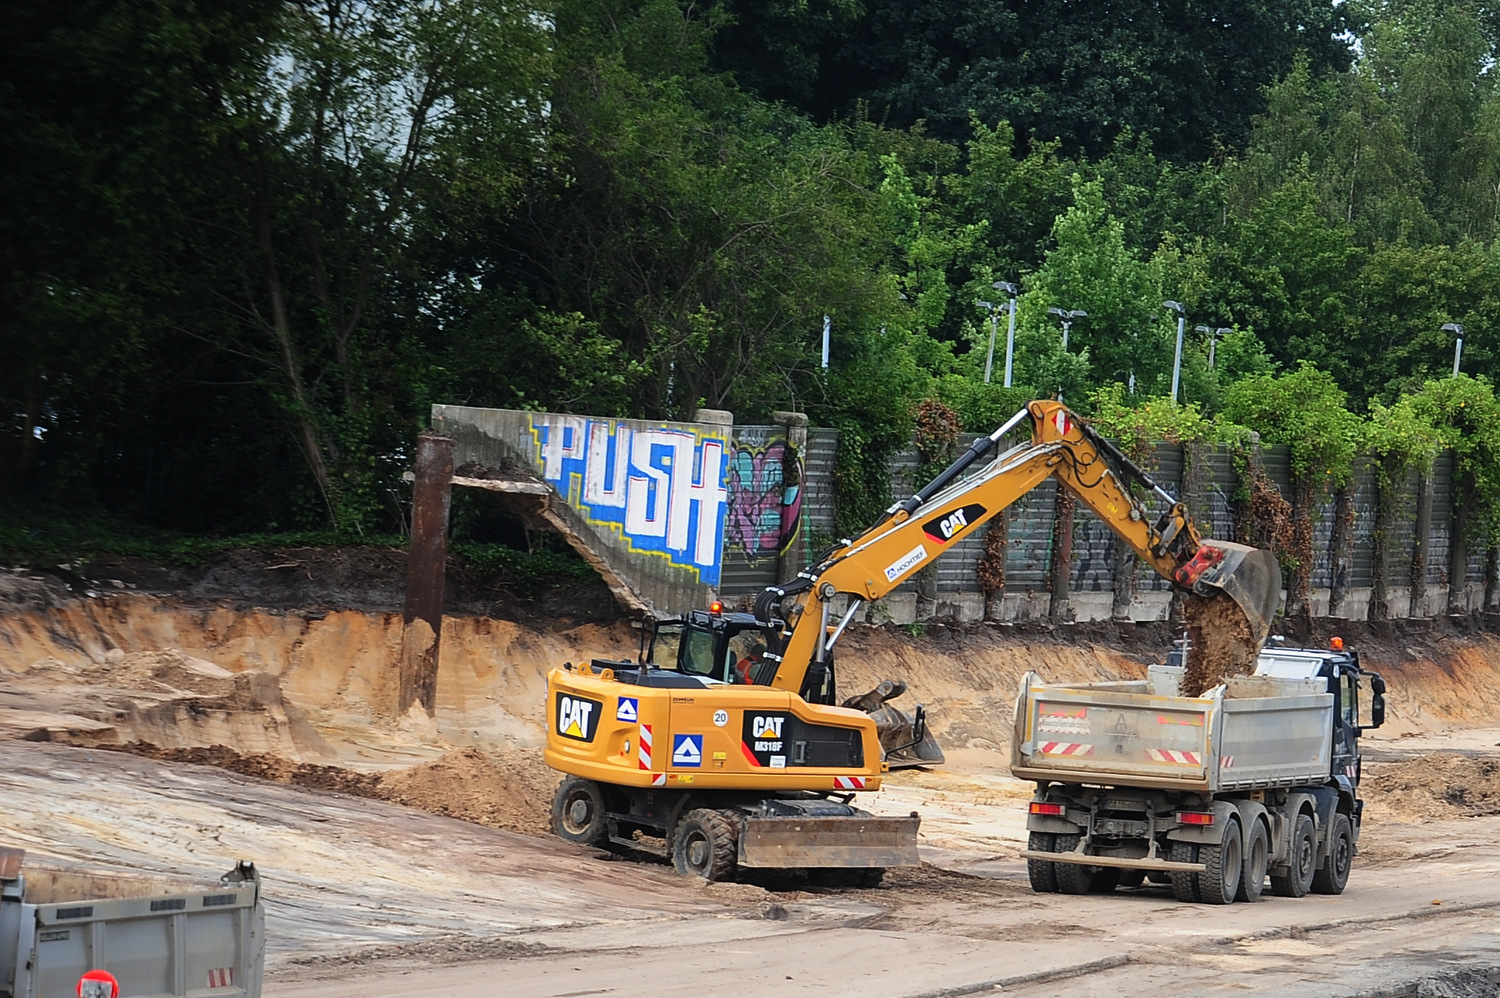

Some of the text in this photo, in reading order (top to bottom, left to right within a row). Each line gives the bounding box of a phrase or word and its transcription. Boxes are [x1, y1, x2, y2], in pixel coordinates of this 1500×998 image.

[543, 417, 727, 566] PUSH
[940, 508, 968, 538] CAT
[896, 550, 924, 573] HOCHTIEF
[560, 696, 592, 739] CAT
[714, 713, 726, 722] 20
[752, 716, 785, 738] CAT
[755, 741, 782, 752] M318F
